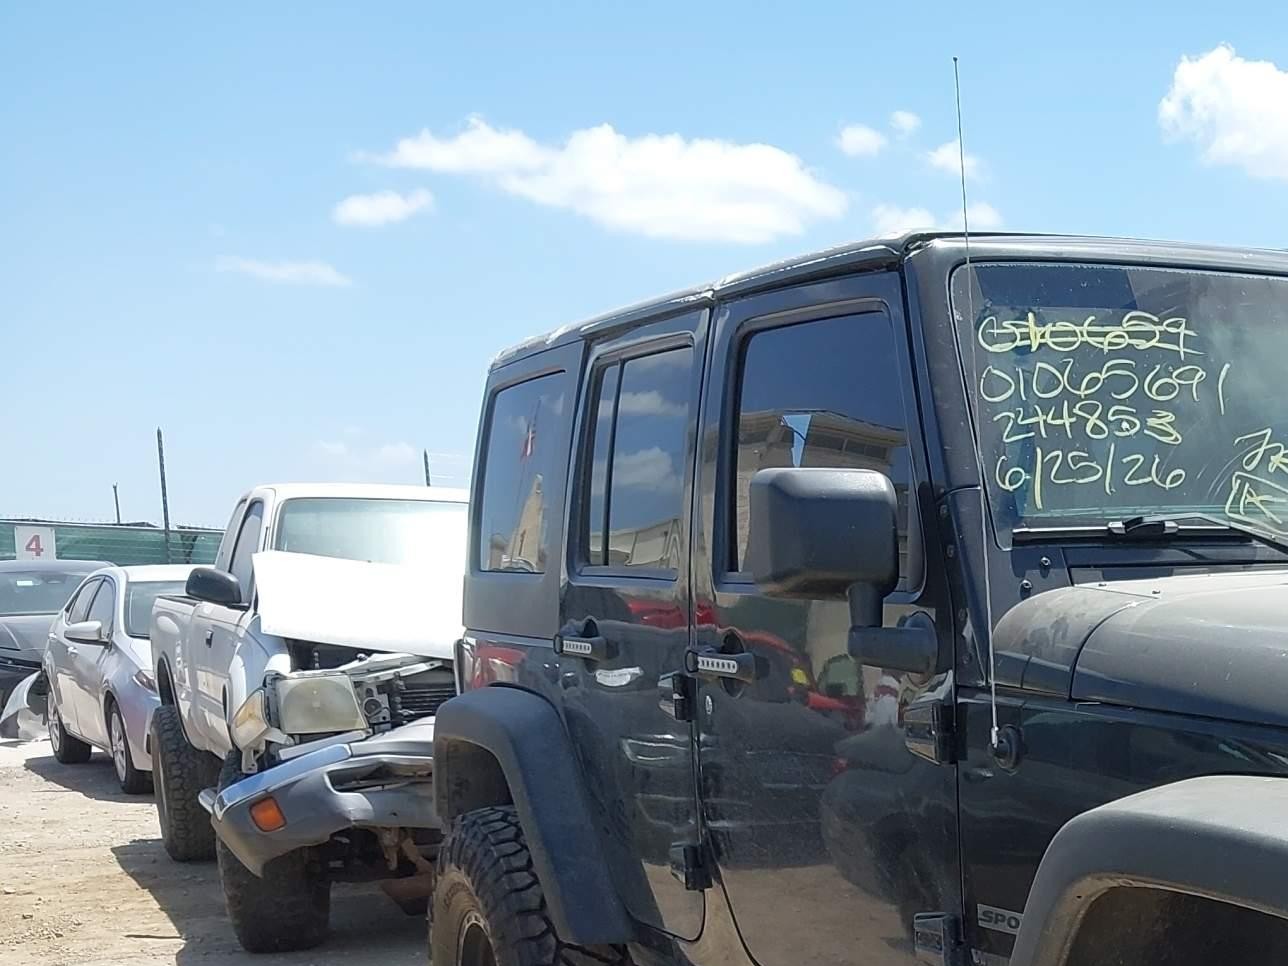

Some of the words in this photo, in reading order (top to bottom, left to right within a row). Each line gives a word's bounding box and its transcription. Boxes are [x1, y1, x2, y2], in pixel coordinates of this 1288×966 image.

[995, 443, 1186, 510] 6/25/26
[25, 534, 44, 557] 4
[979, 909, 1021, 930] SPO
